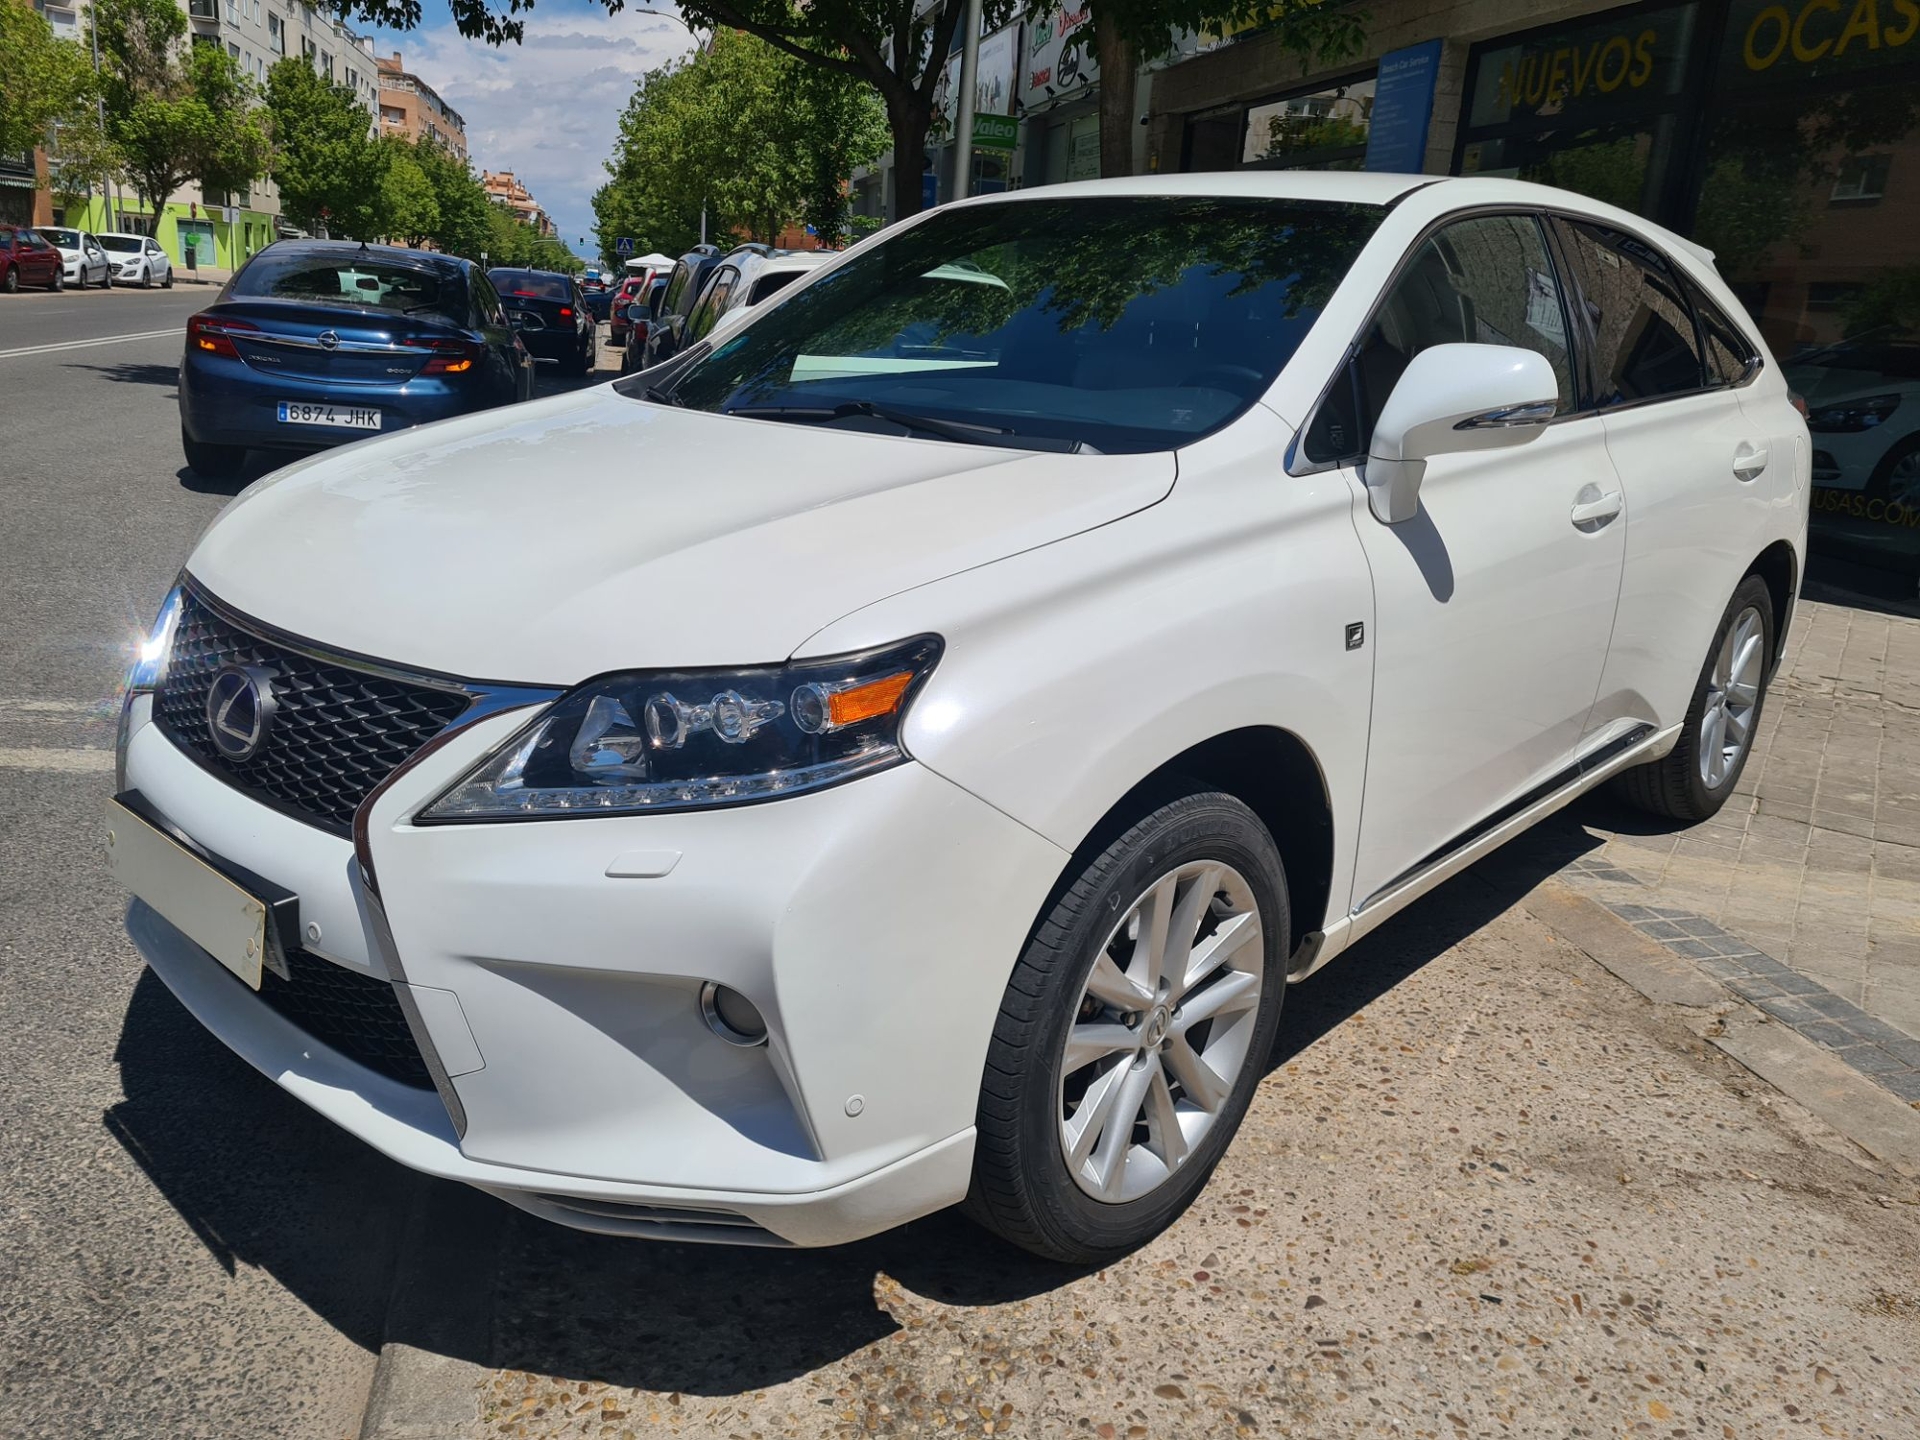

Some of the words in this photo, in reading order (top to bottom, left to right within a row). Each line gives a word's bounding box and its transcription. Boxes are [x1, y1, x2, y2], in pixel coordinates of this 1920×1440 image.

[1743, 0, 1920, 71] OCAS
[1501, 30, 1656, 107] NUEVOS
[289, 405, 335, 423] 6874
[344, 408, 378, 427] JHK
[1811, 487, 1920, 528] USAS.COM
